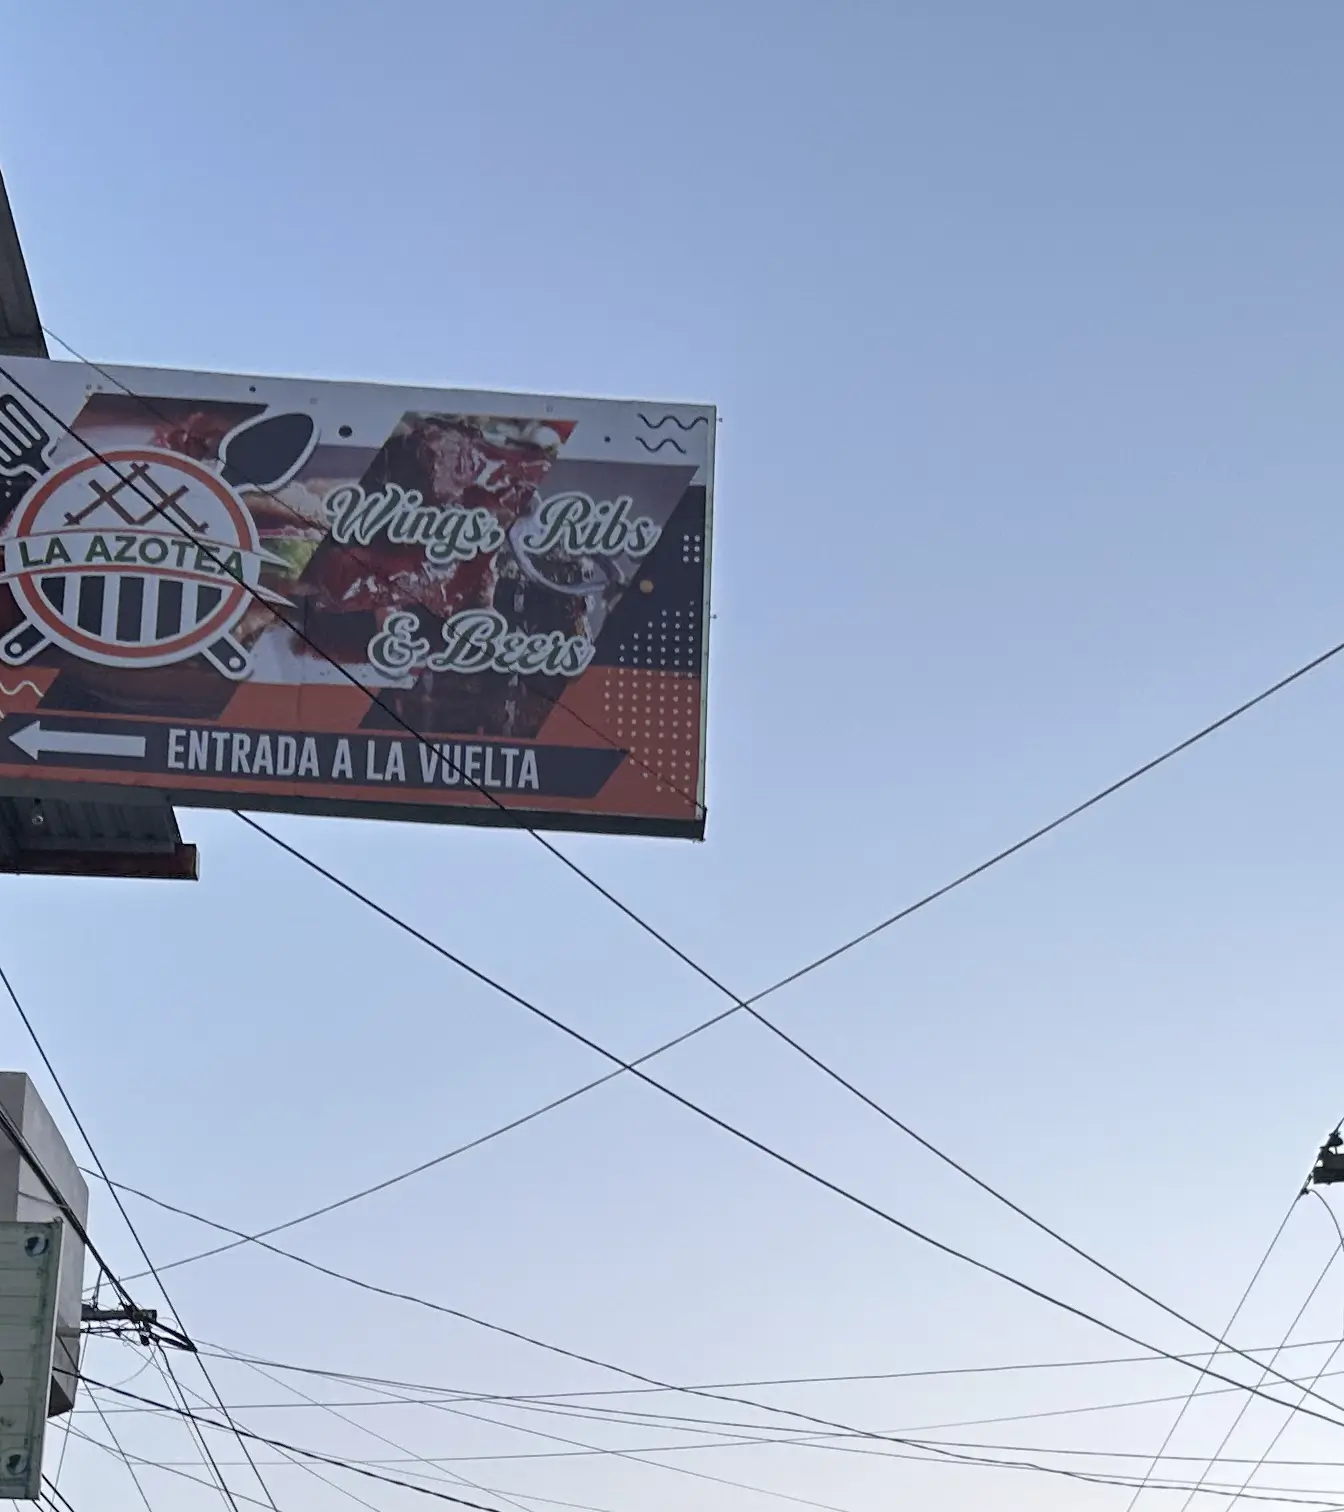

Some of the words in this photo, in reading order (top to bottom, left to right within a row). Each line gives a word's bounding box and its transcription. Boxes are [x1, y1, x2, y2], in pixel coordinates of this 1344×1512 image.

[18, 538, 77, 567] LA
[86, 534, 245, 578] AZOTEA
[325, 483, 504, 564] Wings,
[523, 490, 661, 560] Ribs
[370, 612, 428, 678] &
[430, 608, 596, 678] Beers
[168, 729, 325, 779] ENTRADA
[332, 739, 355, 779] A
[365, 740, 408, 783] LA
[418, 743, 540, 791] VUELTA
